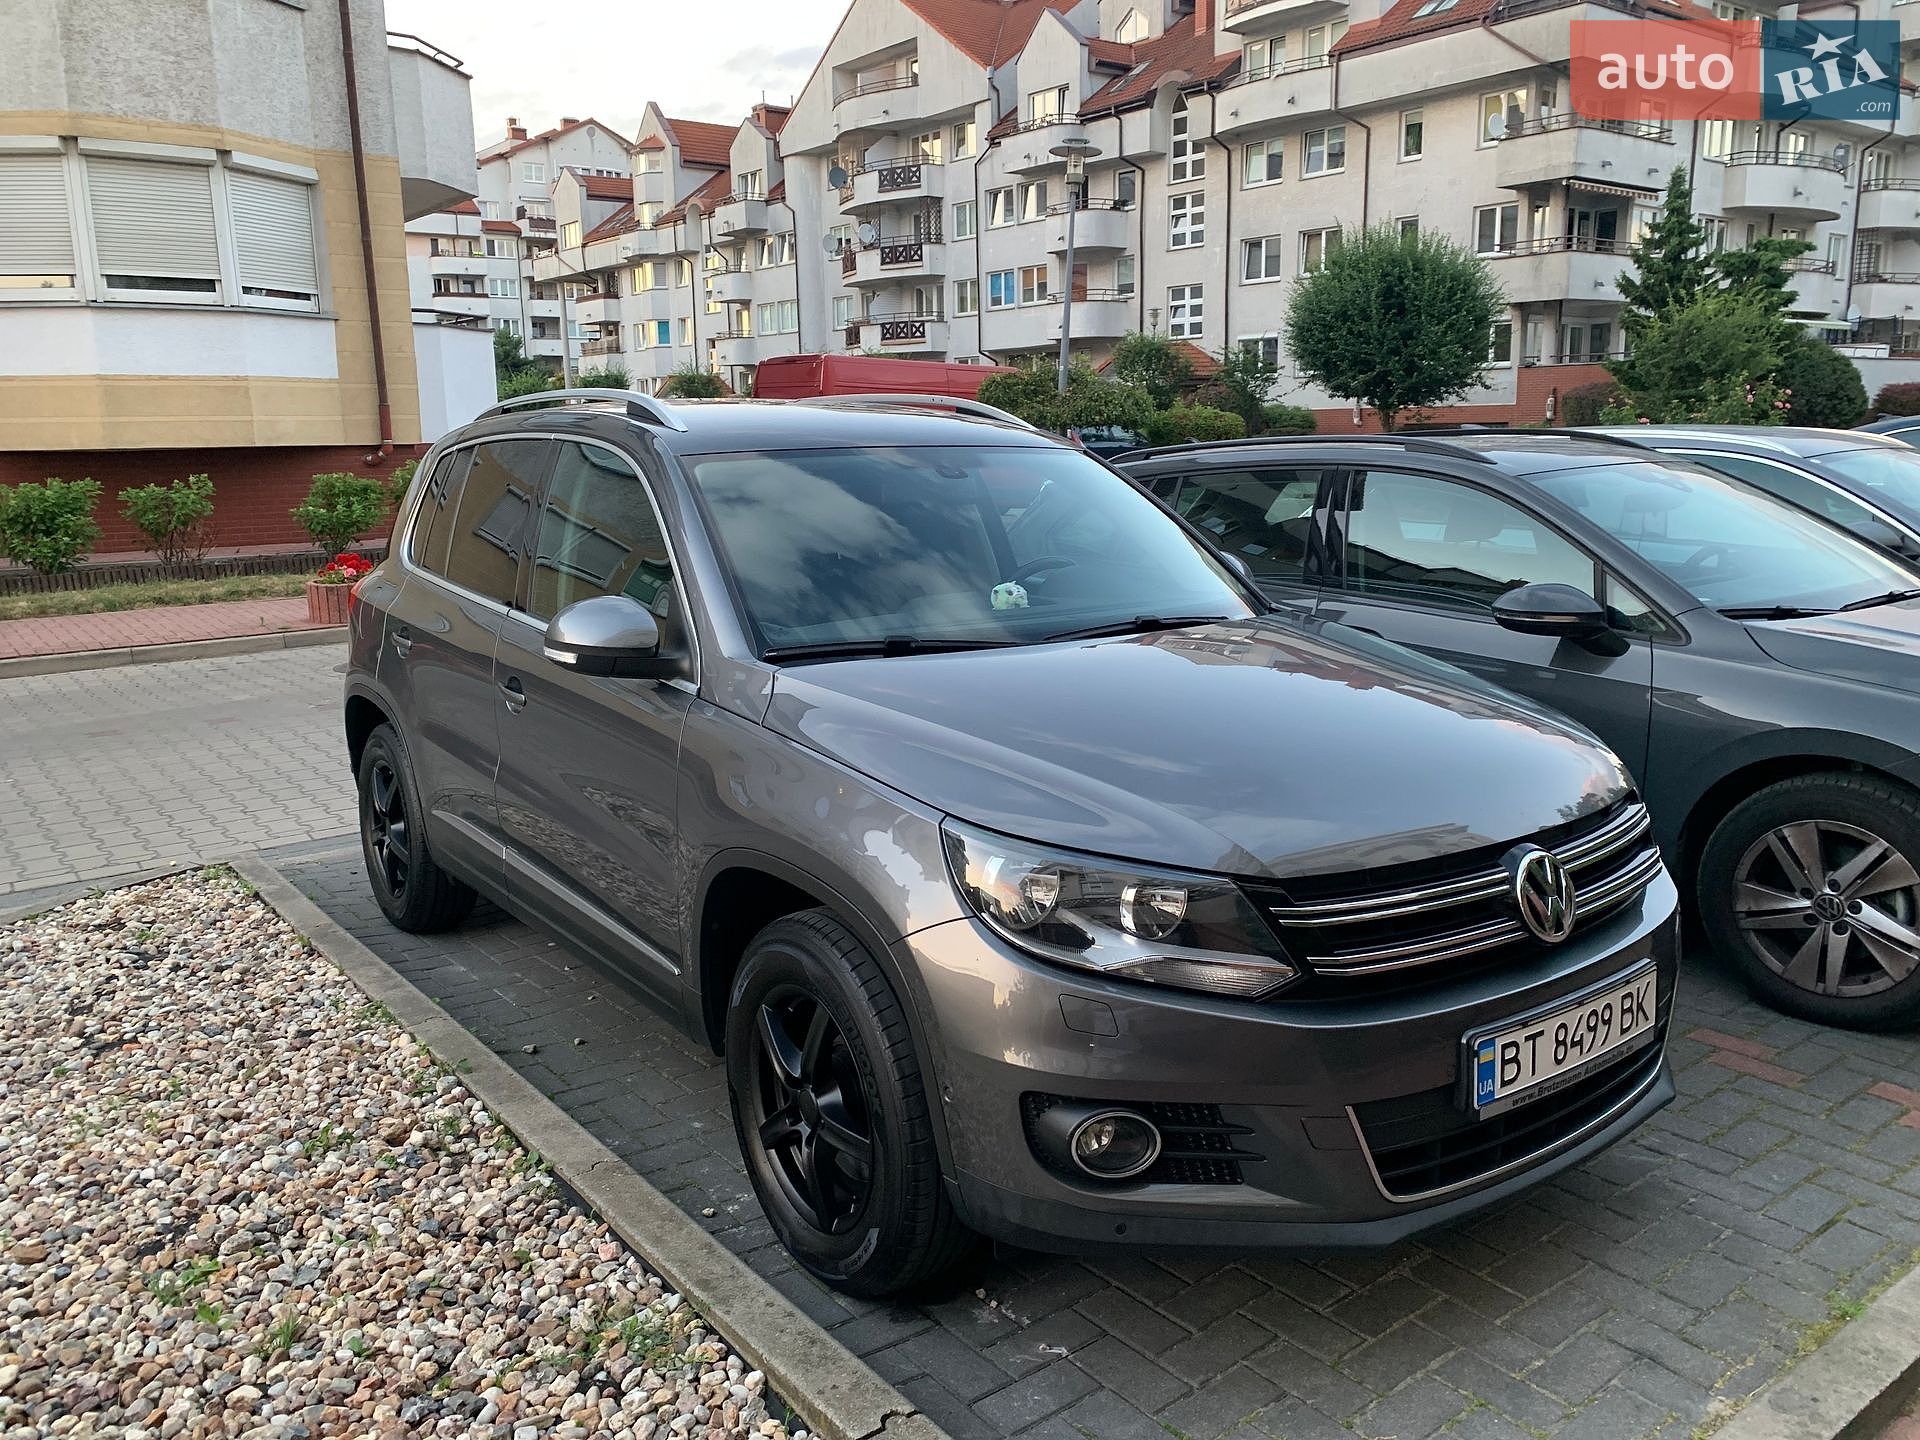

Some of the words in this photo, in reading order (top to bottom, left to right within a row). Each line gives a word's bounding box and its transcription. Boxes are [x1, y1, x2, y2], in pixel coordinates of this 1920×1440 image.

[1500, 1029, 1545, 1089] BT
[1553, 1002, 1613, 1066] 8499
[1619, 981, 1651, 1036] BK
[1479, 1080, 1494, 1096] UA
